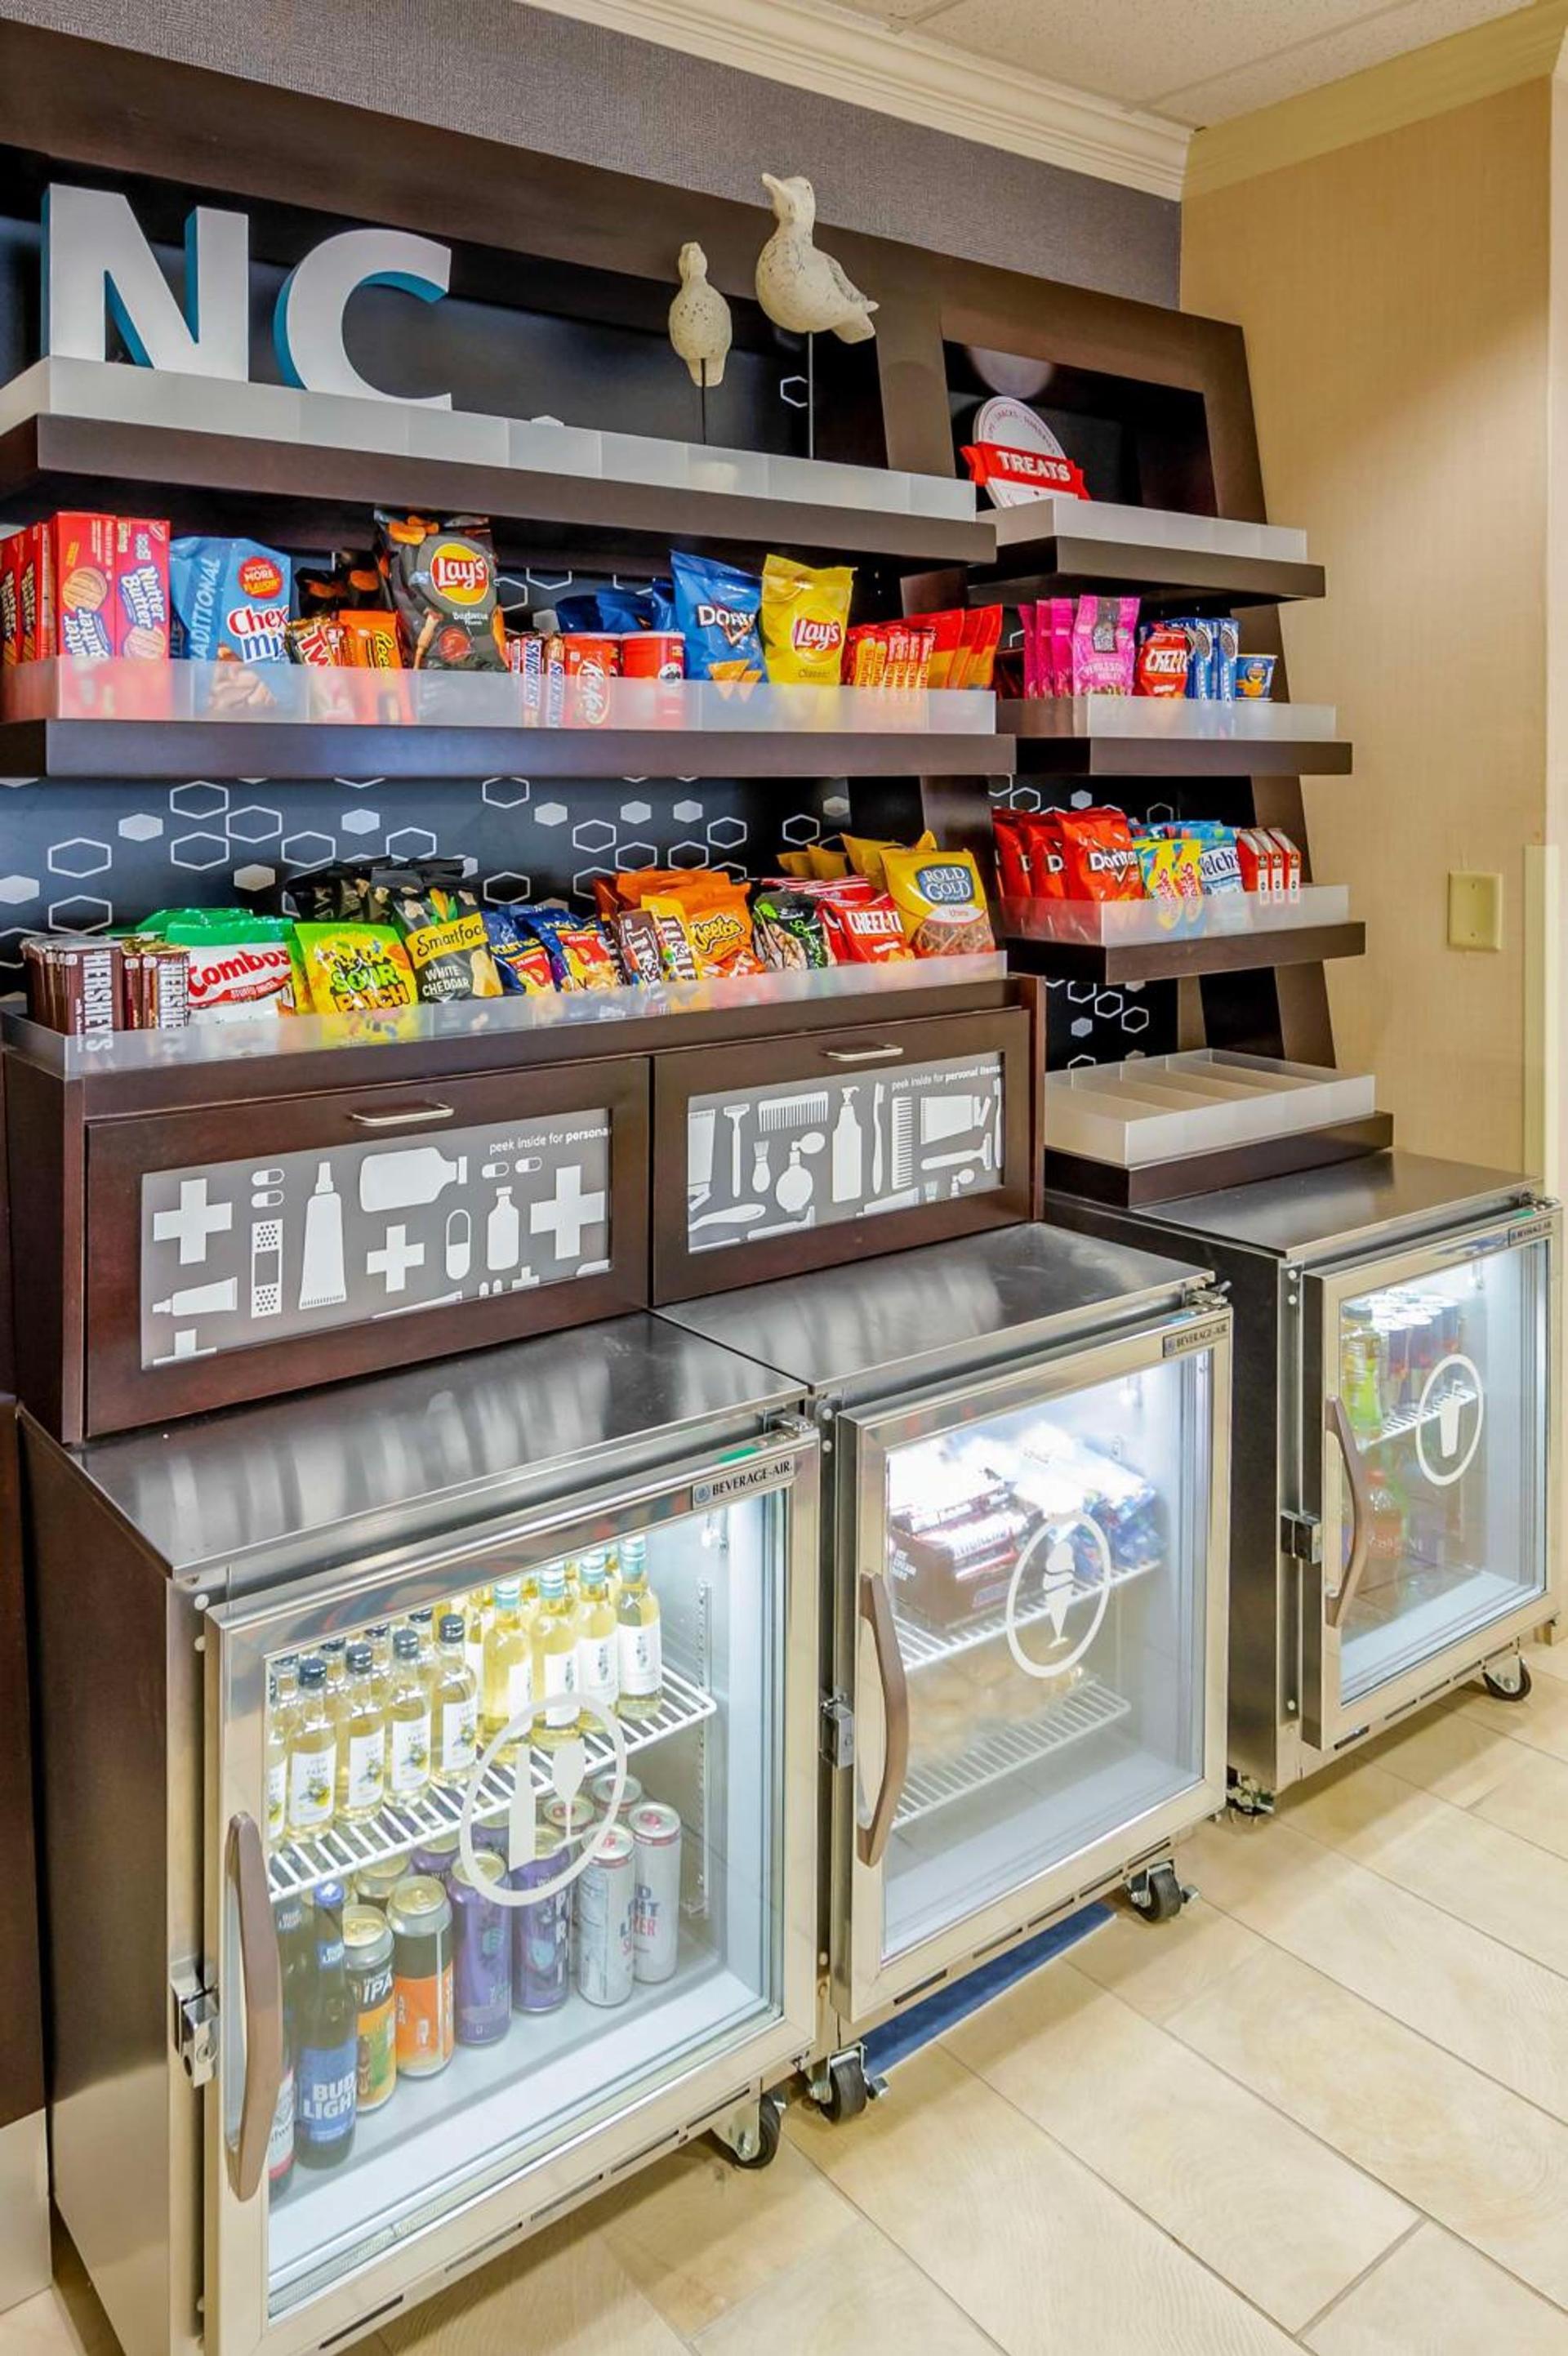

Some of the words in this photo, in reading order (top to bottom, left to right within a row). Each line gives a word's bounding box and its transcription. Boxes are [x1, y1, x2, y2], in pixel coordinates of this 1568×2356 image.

[41, 182, 452, 410] NC
[996, 451, 1071, 482] TREATS
[245, 568, 274, 581] MORE
[438, 558, 487, 590] Lay's
[121, 573, 153, 630] Butter
[137, 565, 165, 621] Nutter
[189, 558, 220, 660] ADITIONAL
[228, 605, 290, 635] Chex
[64, 614, 87, 655] utter
[795, 618, 840, 651] Lay's
[924, 867, 964, 882] ROLD
[926, 880, 972, 901] GOLD
[416, 924, 483, 957] Smartfoo
[188, 950, 292, 997] Combos
[331, 964, 399, 992] SOUR
[422, 978, 470, 996] CHEDDAR
[425, 965, 460, 981] WHITE
[83, 954, 114, 1052] HERSHEY'S
[333, 982, 410, 1013] PATCH
[945, 1067, 978, 1084] personal
[490, 1138, 514, 1155] peek
[518, 1134, 546, 1149] inside
[549, 1132, 564, 1143] for
[712, 1460, 791, 1496] BEVERAGE-AIR
[363, 1972, 393, 2004] IPA
[313, 2070, 356, 2101] BUD
